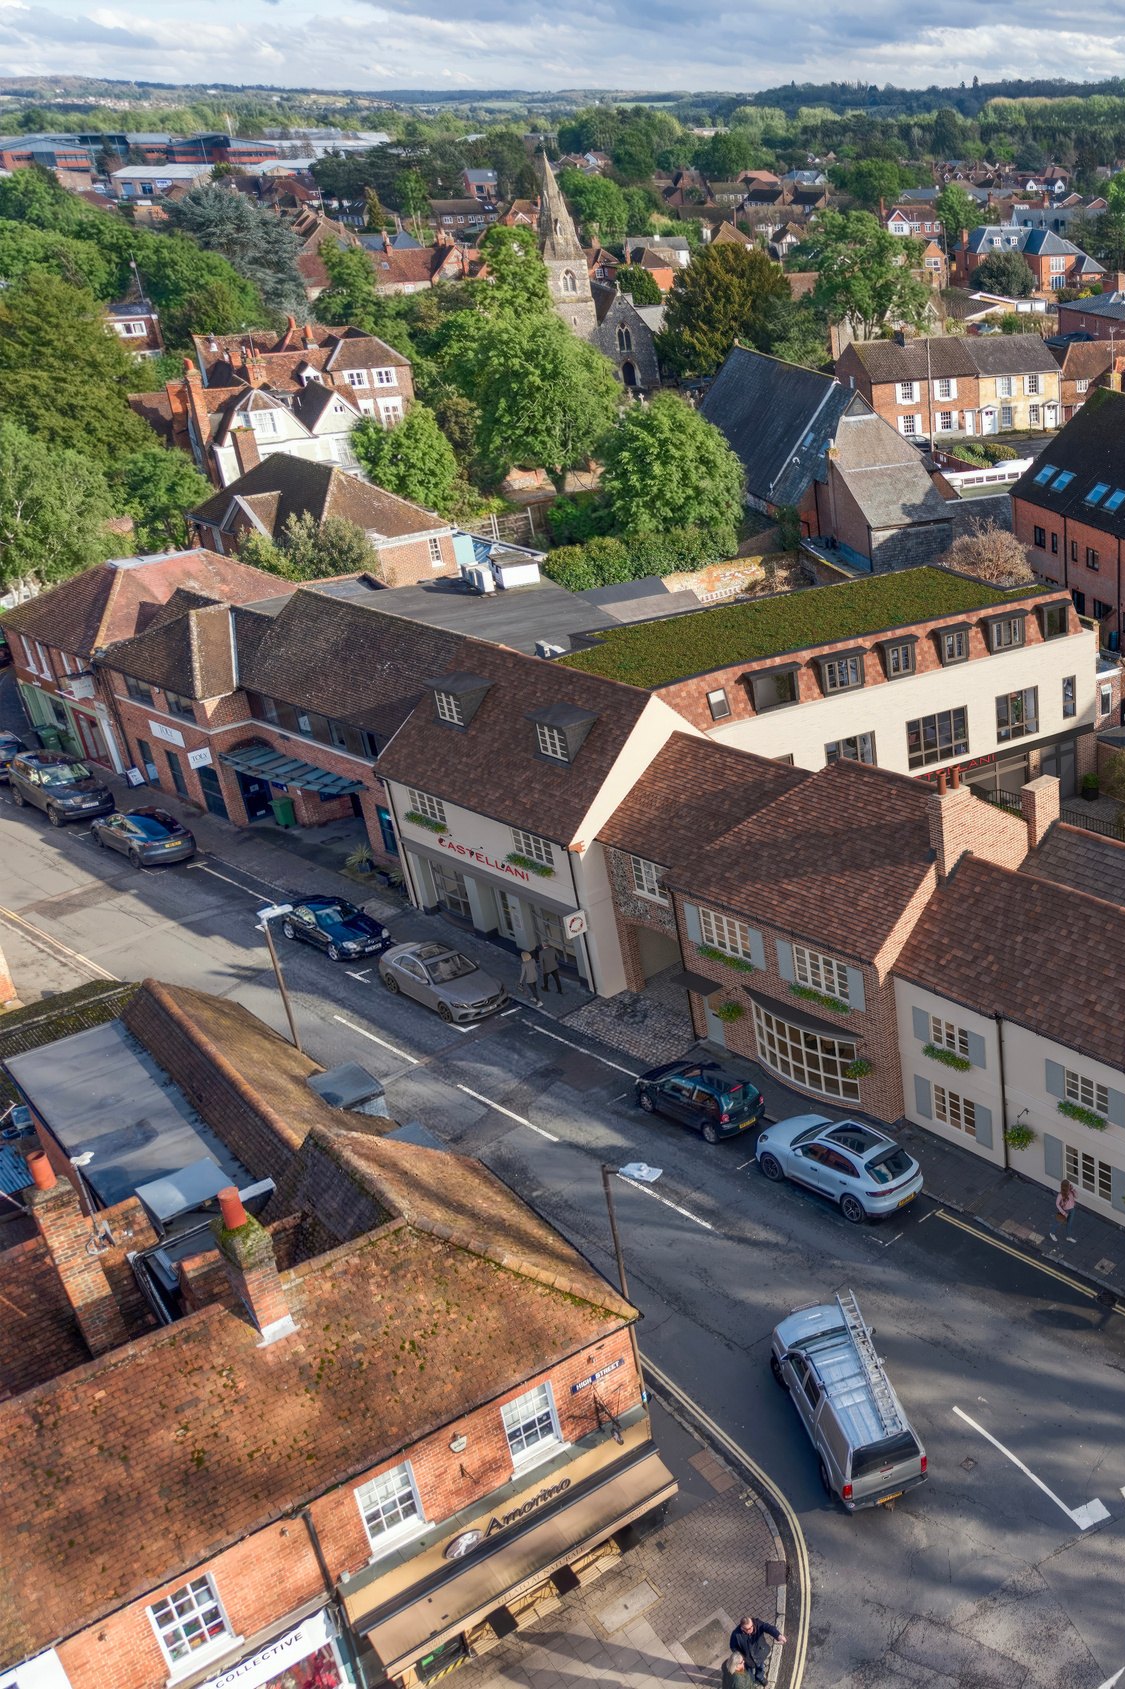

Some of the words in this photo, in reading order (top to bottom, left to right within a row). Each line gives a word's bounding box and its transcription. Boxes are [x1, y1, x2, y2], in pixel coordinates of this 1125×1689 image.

[438, 837, 529, 881] CASTELLANI
[576, 1377, 592, 1391] HIGH
[595, 1360, 620, 1379] STREET
[484, 1478, 572, 1538] Amorino
[215, 1631, 304, 1689] COLLECTIVE
